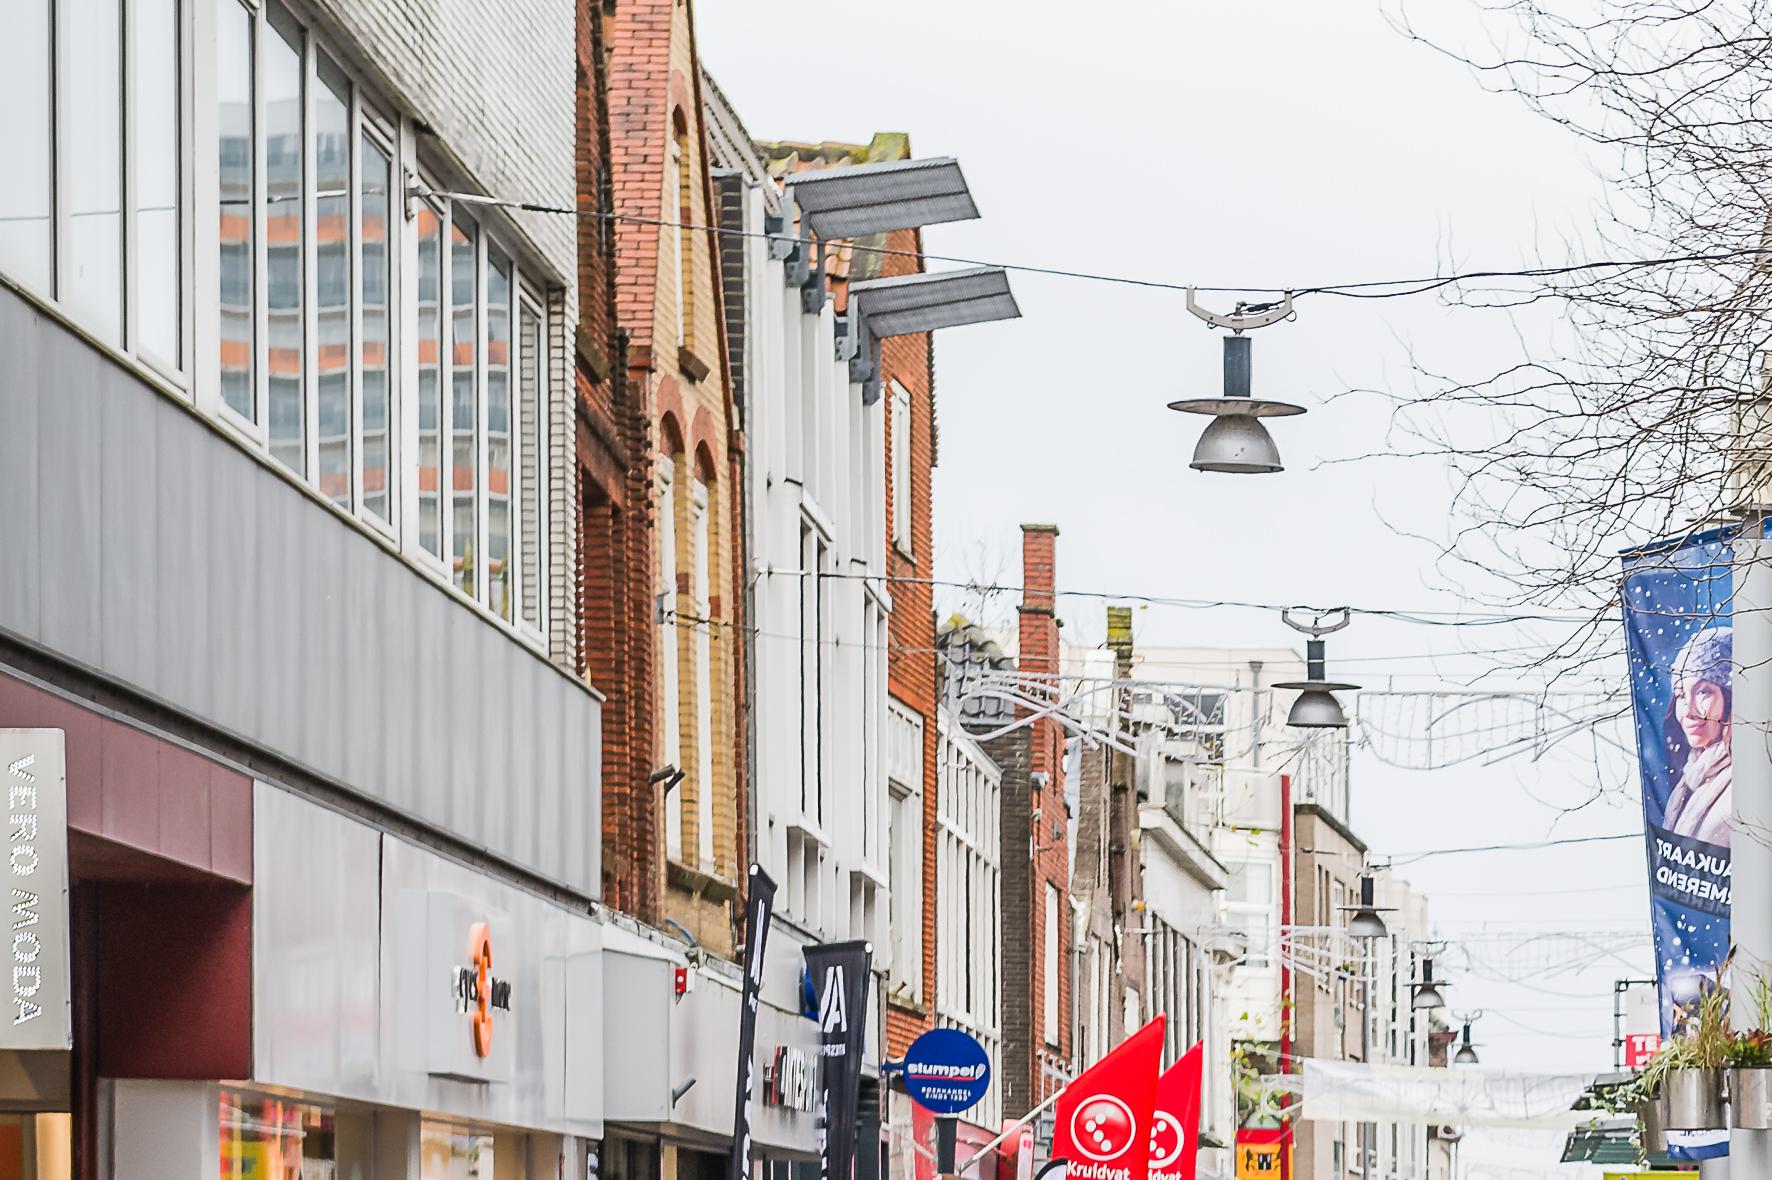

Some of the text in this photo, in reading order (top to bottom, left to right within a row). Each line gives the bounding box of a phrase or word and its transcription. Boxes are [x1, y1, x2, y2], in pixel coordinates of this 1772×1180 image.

[8, 753, 43, 1027] VERO MODA
[907, 1062, 975, 1078] stumpel
